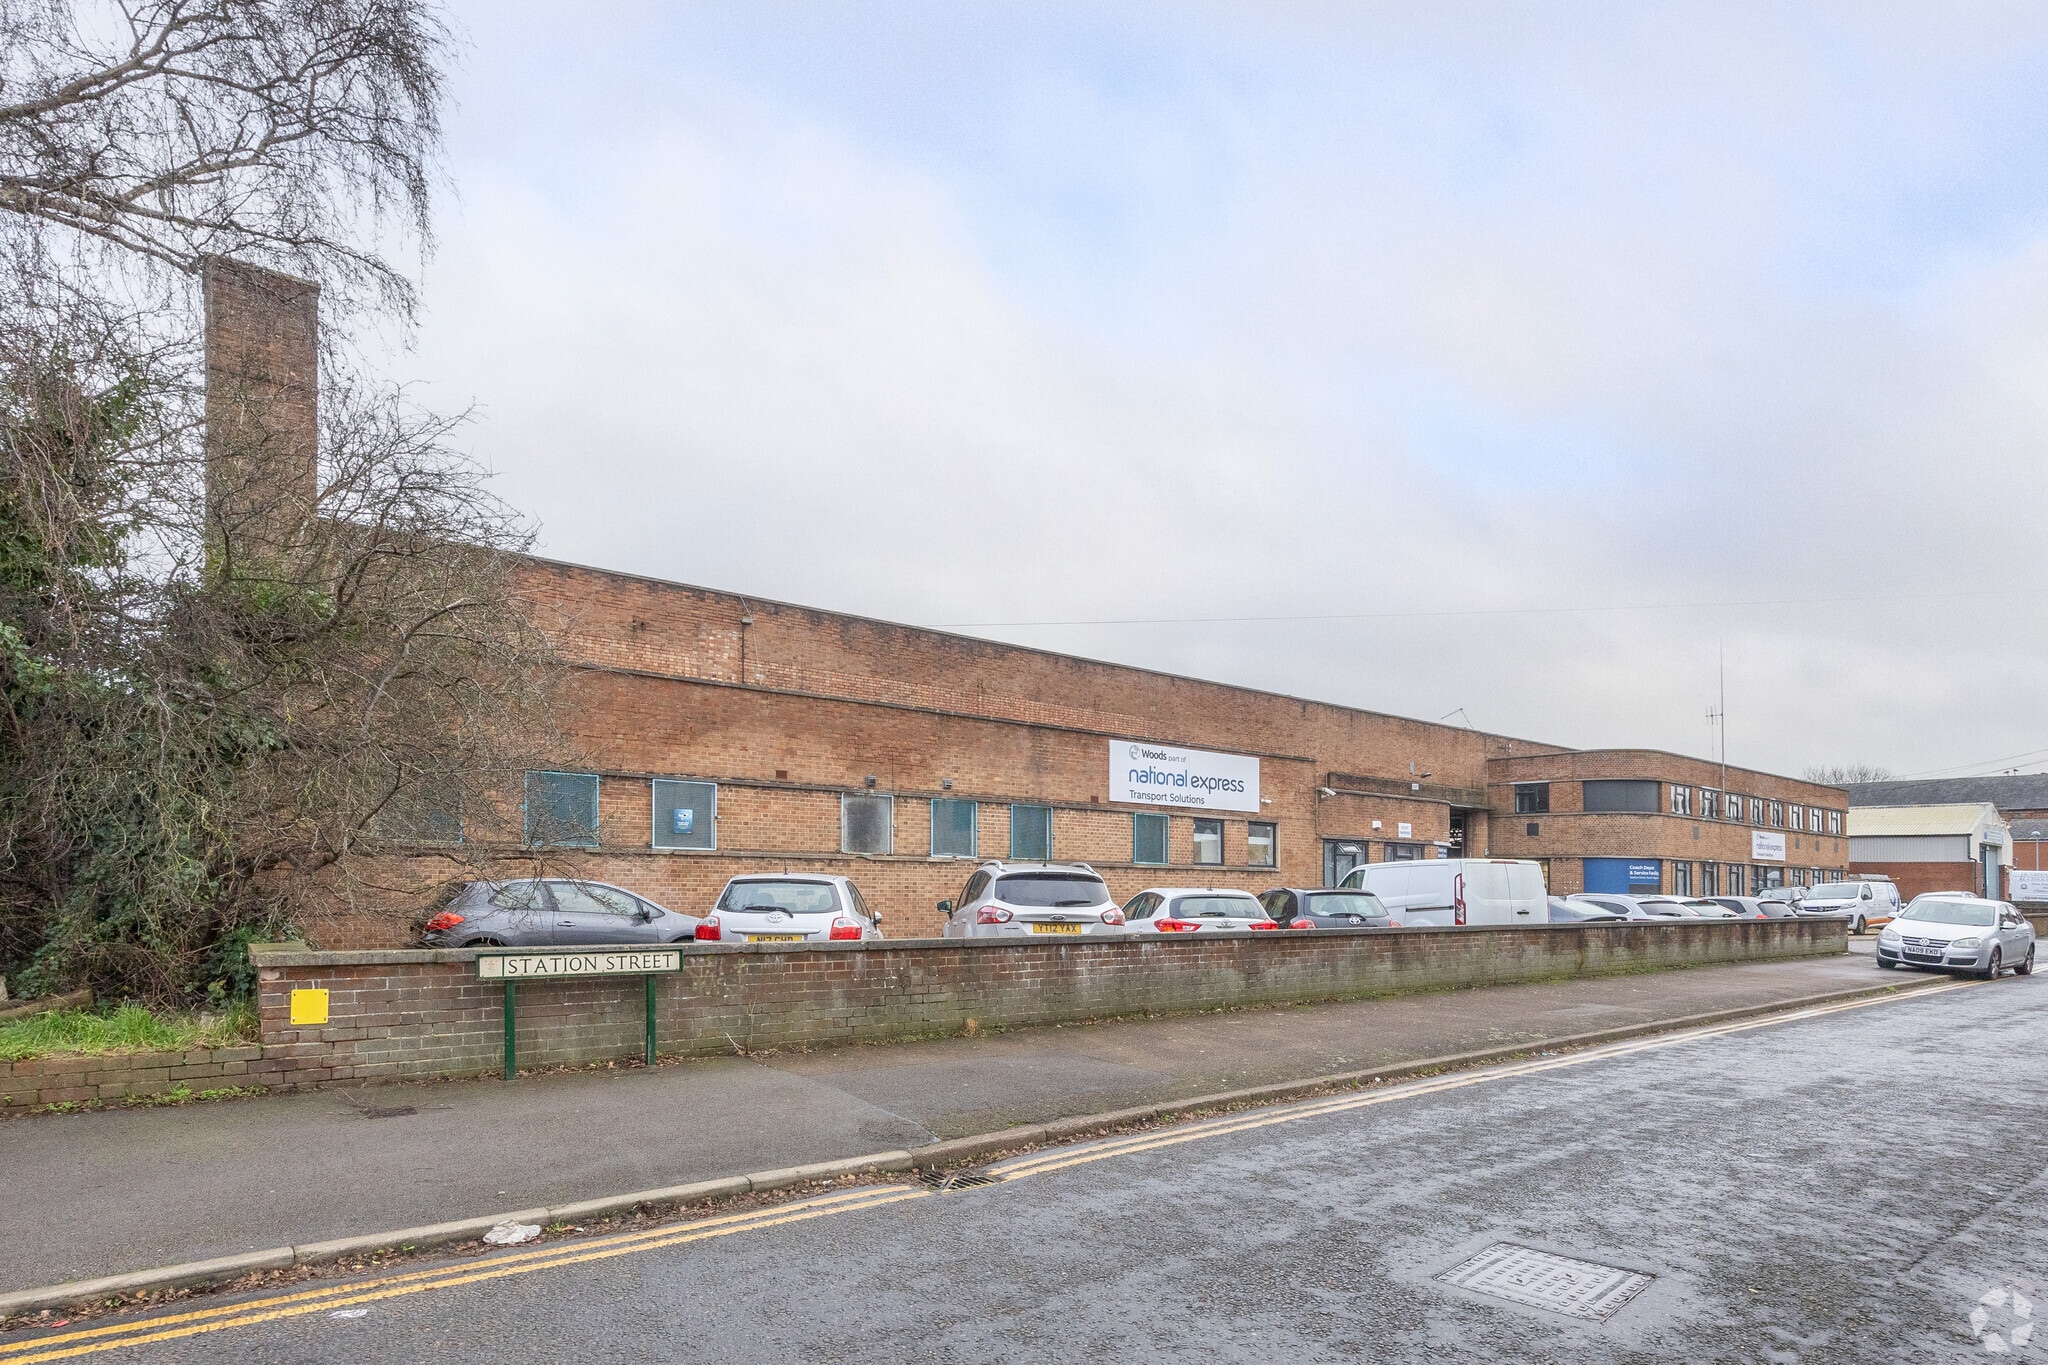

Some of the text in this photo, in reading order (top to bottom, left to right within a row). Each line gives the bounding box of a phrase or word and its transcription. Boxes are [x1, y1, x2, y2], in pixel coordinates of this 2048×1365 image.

[1142, 748, 1167, 760] Woods
[1168, 755, 1180, 763] part
[1129, 765, 1245, 794] national express
[1129, 789, 1205, 805] Transport Solutions
[1038, 923, 1077, 933] YT12 YAX
[508, 953, 675, 974] STATION STREET
